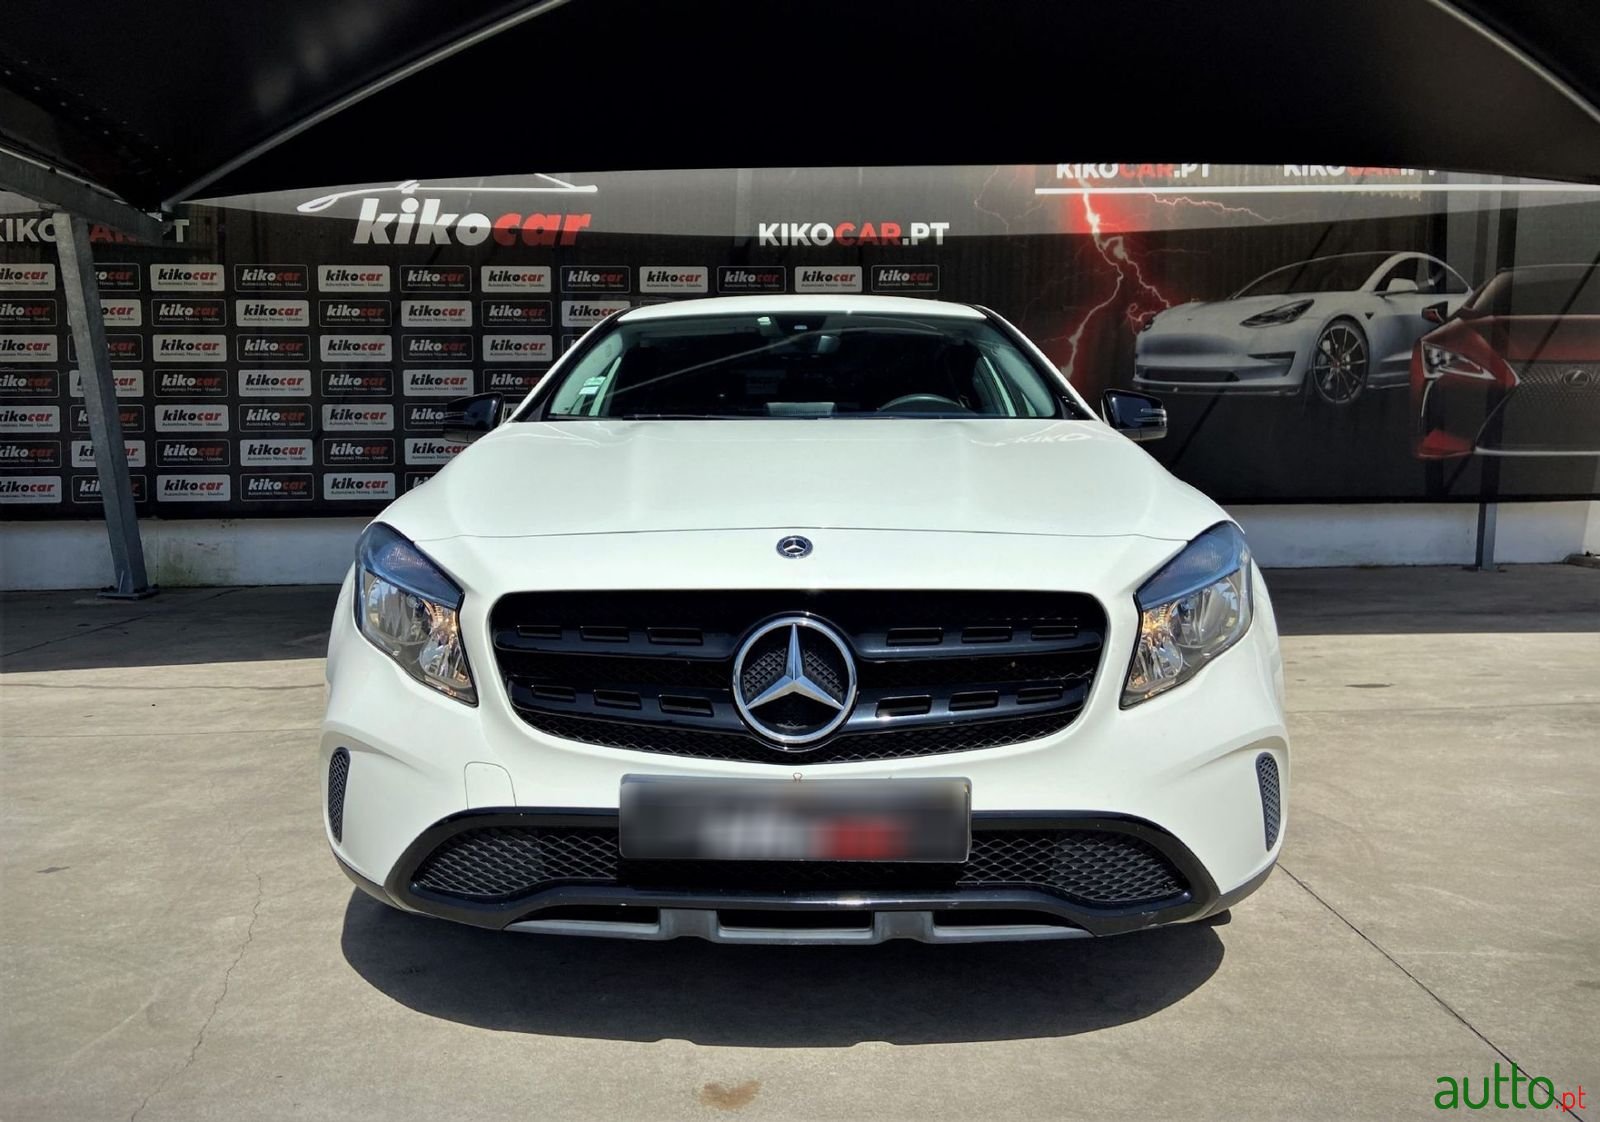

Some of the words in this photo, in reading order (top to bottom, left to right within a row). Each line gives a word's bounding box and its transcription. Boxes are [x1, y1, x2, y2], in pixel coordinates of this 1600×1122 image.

[353, 198, 592, 246] kikocar
[759, 222, 950, 246] KIKOCAR.PT
[0, 268, 48, 280] ikocar
[158, 268, 217, 281] kikocar
[242, 269, 301, 281] kikocar
[325, 269, 383, 281] kikocar
[407, 270, 464, 282] kikocar
[488, 270, 545, 282] kikocar
[568, 270, 624, 282] kikocar
[647, 270, 702, 282] kikocar
[724, 271, 779, 283] kikocar
[802, 270, 857, 282] kikocar
[879, 269, 933, 282] kikocar
[0, 303, 49, 316] ikocar
[159, 304, 219, 316] kikocar
[243, 304, 302, 316] kikocar
[326, 304, 385, 316] kikocar
[408, 304, 465, 316] kikocar
[489, 304, 545, 317] kikocar
[0, 339, 50, 351] ikocar
[160, 339, 219, 351] kikocar
[244, 339, 304, 351] kikocar
[327, 339, 385, 351] kikocar
[409, 339, 466, 351] kikocar
[490, 339, 546, 351] kikocar
[161, 374, 221, 386] kikocar
[245, 374, 305, 386] kikocar
[328, 373, 387, 386] kikocar
[410, 373, 467, 385] kikocar
[162, 409, 222, 421] kikocar
[246, 409, 305, 421] kikocar
[329, 408, 387, 420] kikocar
[163, 444, 224, 456] kikocar
[247, 444, 306, 456] kikocar
[330, 443, 388, 455] kikocar
[412, 442, 467, 454] kikoca
[164, 479, 224, 491] kikocar
[248, 478, 307, 491] kikocar
[331, 477, 389, 490] kikocar
